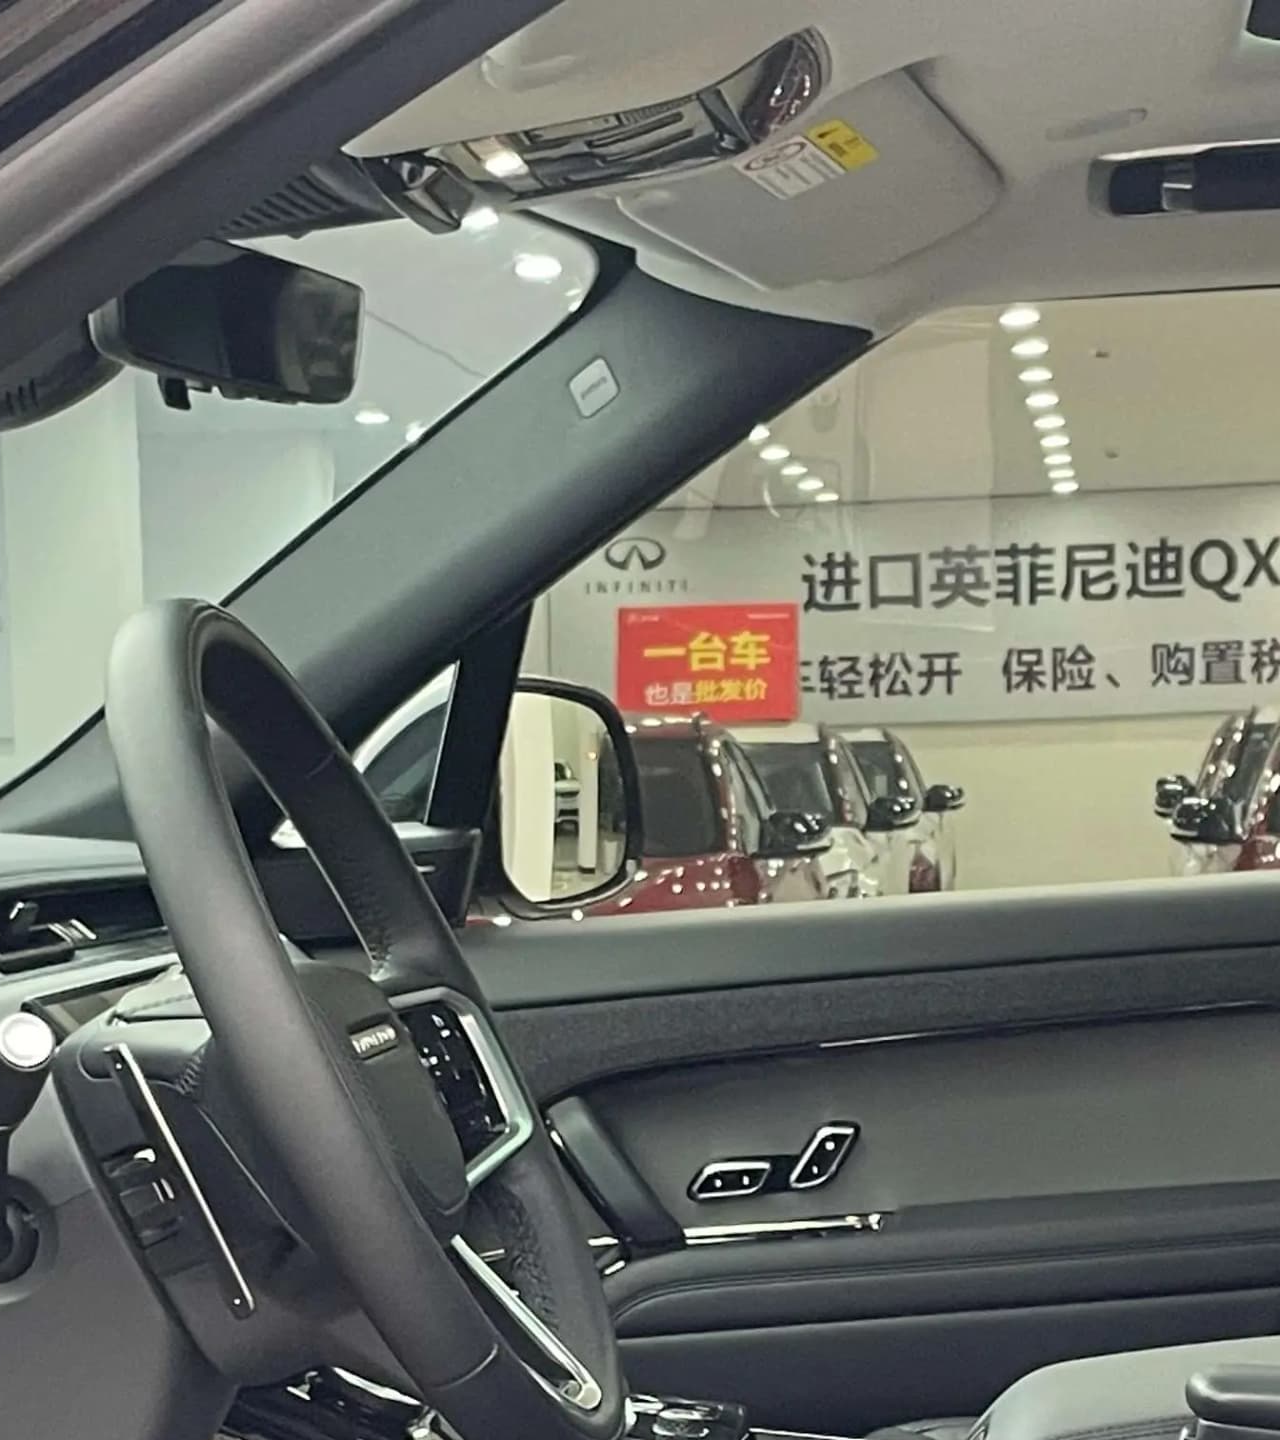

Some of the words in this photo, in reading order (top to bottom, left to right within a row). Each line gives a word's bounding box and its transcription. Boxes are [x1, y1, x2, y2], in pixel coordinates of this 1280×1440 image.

[584, 578, 689, 595] INFINITI
[643, 631, 772, 673] 一台车
[644, 678, 768, 706] 也是批发价
[801, 651, 963, 700] 轻松开
